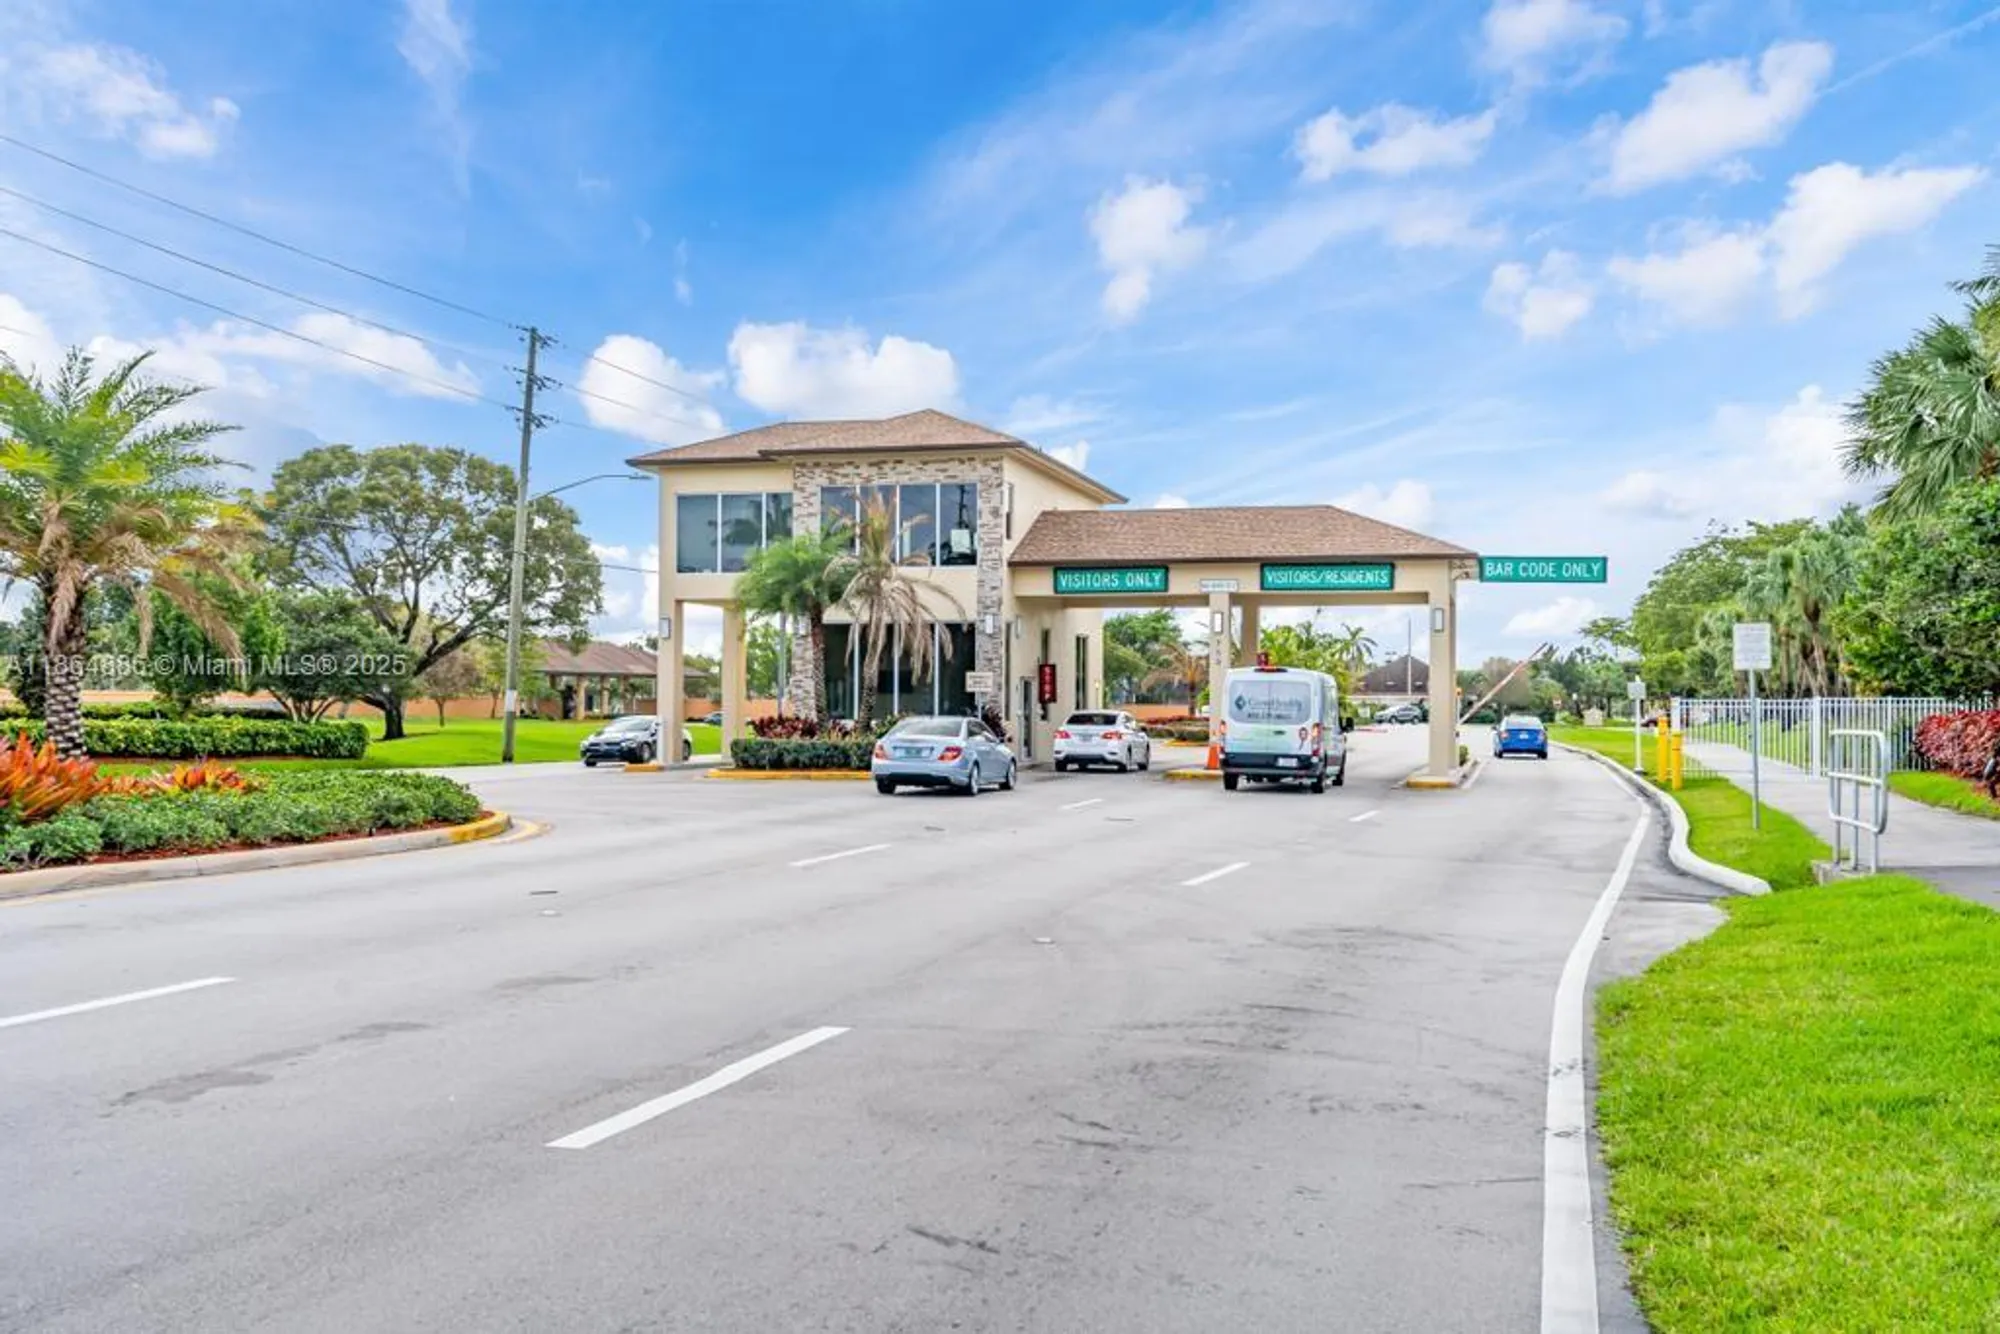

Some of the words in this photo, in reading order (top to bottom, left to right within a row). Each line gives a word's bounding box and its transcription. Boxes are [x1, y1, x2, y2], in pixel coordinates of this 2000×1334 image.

[1264, 568, 1388, 584] VISITORS/RESIDENTS
[1485, 562, 1513, 577] BAR
[1519, 562, 1557, 577] CODE
[1562, 562, 1601, 577] ONLY
[1060, 571, 1119, 588] VISITORS
[1126, 571, 1162, 588] ONLY
